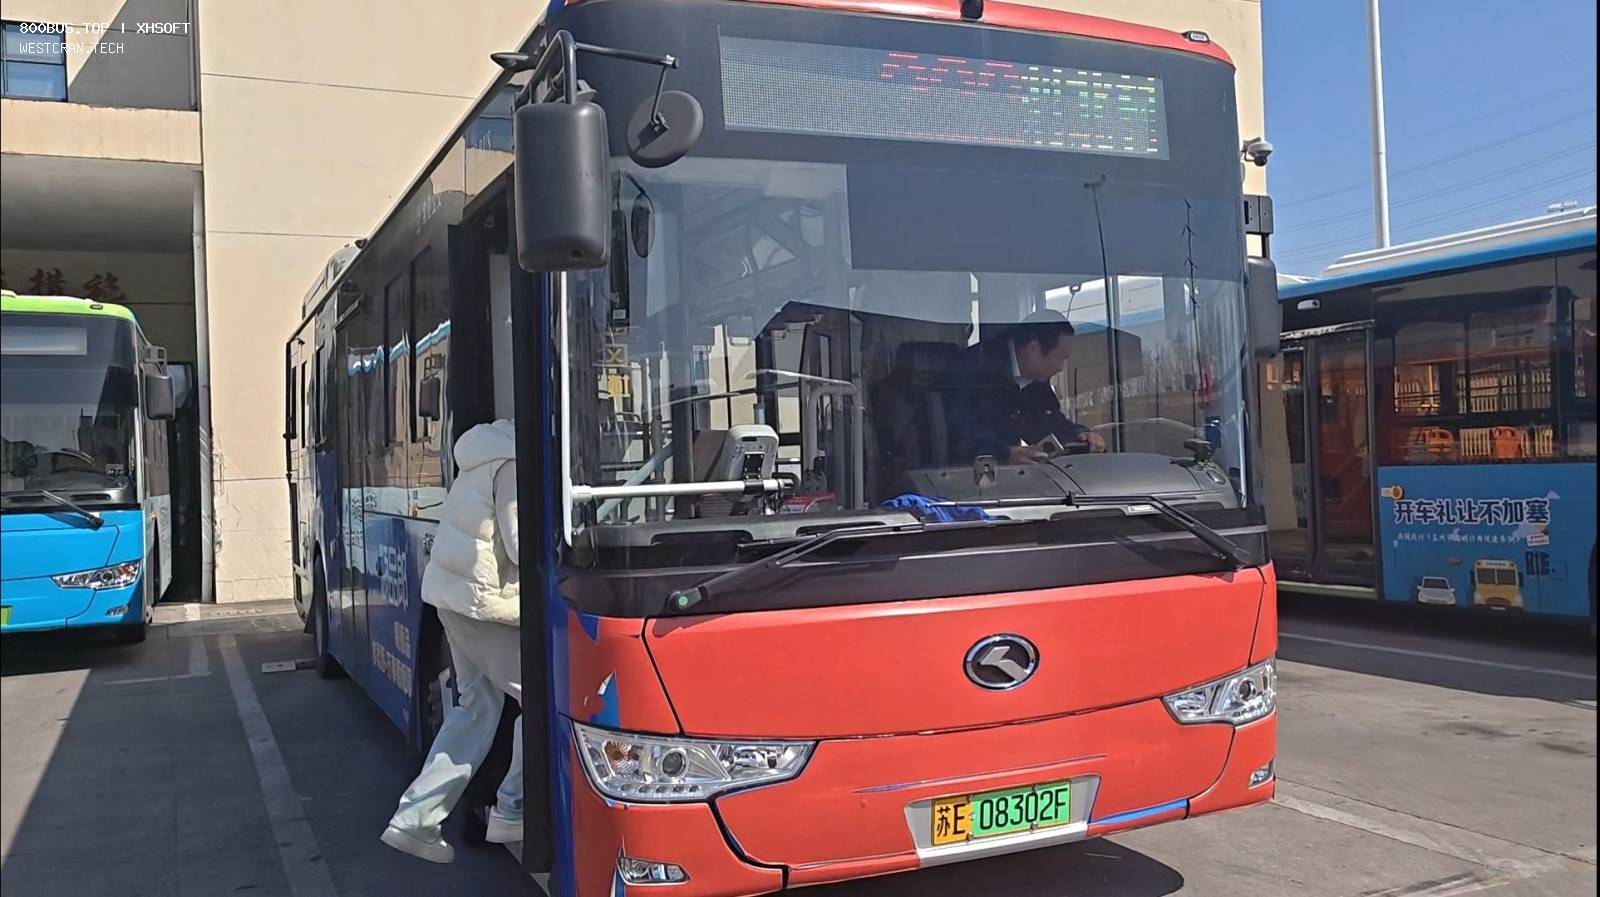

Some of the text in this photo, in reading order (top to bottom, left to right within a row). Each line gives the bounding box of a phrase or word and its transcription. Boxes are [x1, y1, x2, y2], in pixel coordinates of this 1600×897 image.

[1395, 498, 1550, 525] 开车礼让不加塞
[936, 789, 1067, 837] 苏E 08302F
